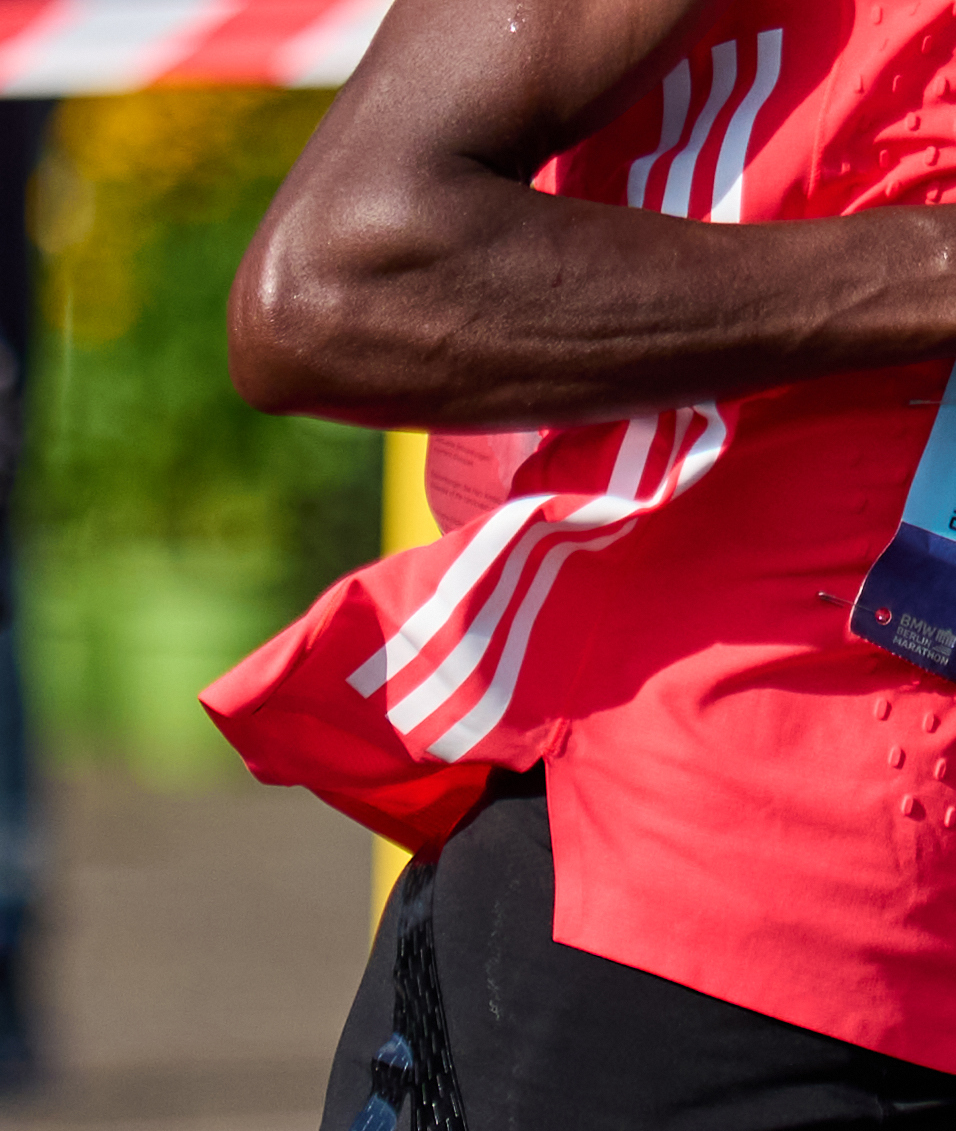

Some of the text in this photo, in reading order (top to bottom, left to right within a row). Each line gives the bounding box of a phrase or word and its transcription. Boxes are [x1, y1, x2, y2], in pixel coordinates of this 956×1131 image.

[896, 626, 932, 648] BERLIN
[900, 613, 937, 637] BMW
[892, 635, 949, 666] MARATHON
